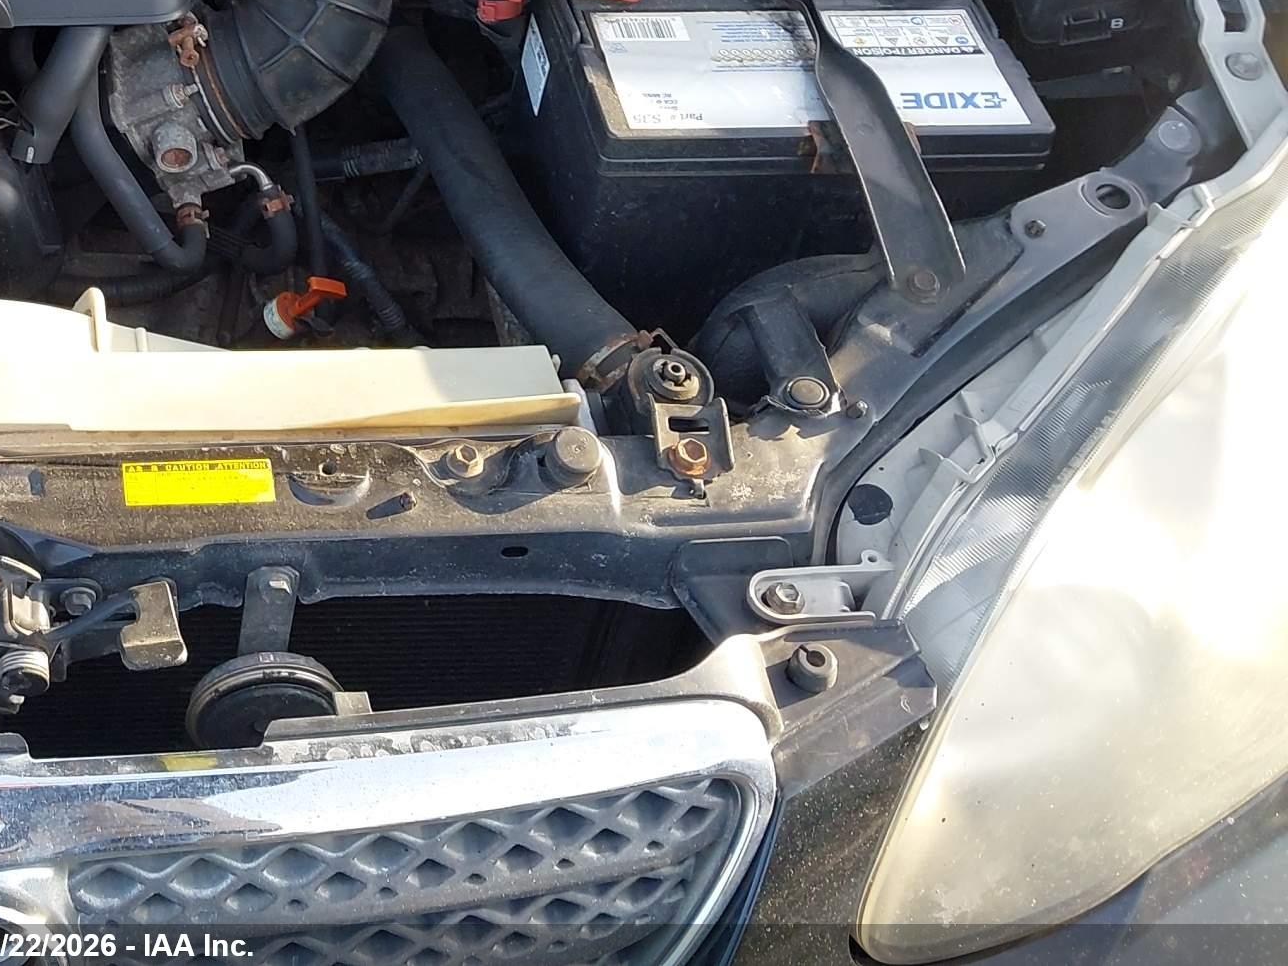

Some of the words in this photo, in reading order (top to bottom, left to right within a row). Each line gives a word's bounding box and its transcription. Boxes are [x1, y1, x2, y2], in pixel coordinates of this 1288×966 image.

[900, 91, 1007, 110] EXIDE
[679, 113, 704, 121] Part
[165, 463, 210, 472] CAUTION
[216, 462, 266, 471] ATTENTION
